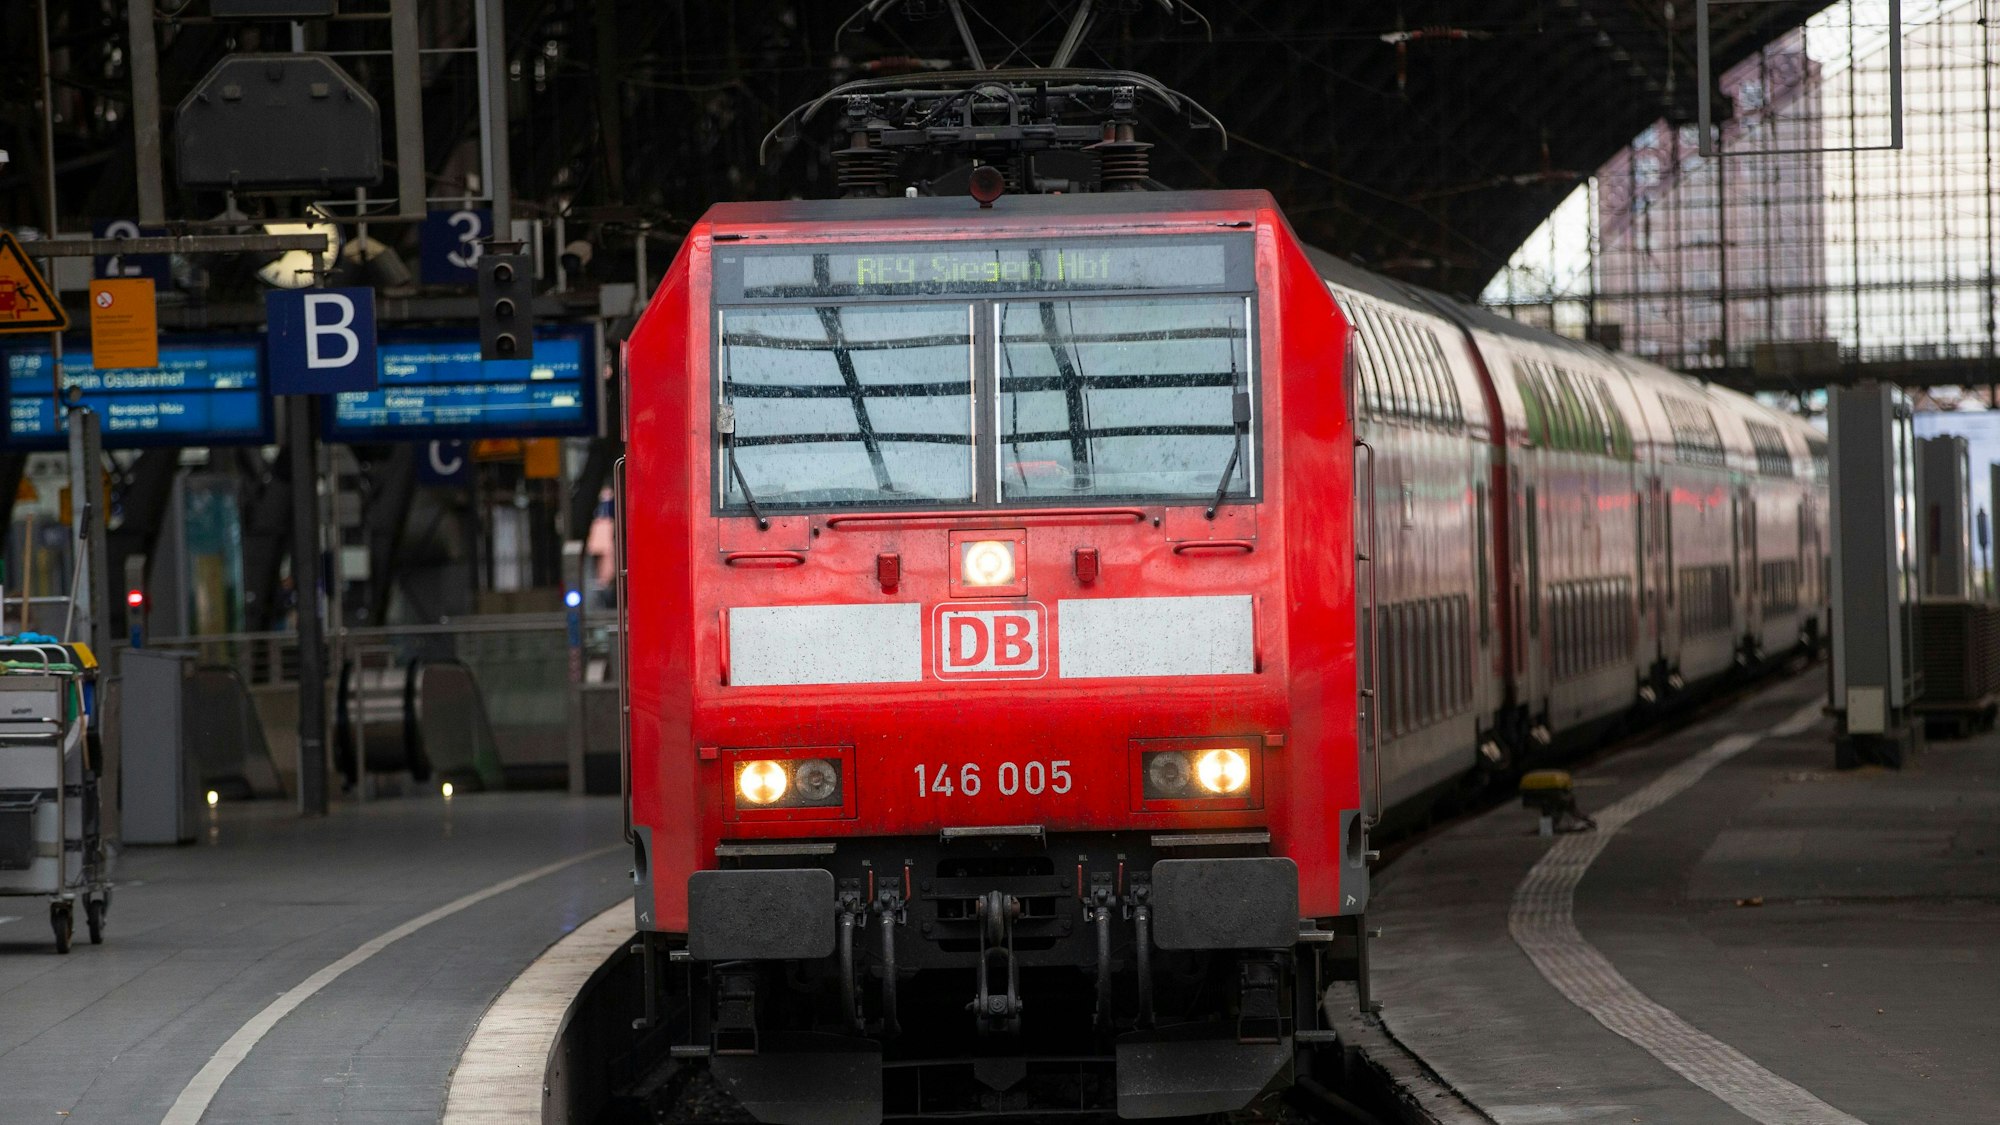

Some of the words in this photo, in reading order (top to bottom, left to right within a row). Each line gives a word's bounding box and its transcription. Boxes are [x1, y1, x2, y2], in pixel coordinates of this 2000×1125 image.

[105, 220, 142, 277] 2
[447, 211, 484, 268] 3
[931, 254, 1041, 283] Siegen
[1057, 251, 1110, 281] Hbf
[303, 292, 360, 370] B
[103, 371, 185, 388] Ostbahnhof
[429, 438, 463, 475] C
[948, 614, 1034, 667] DB
[914, 762, 981, 798] 146
[998, 760, 1072, 796] 005
